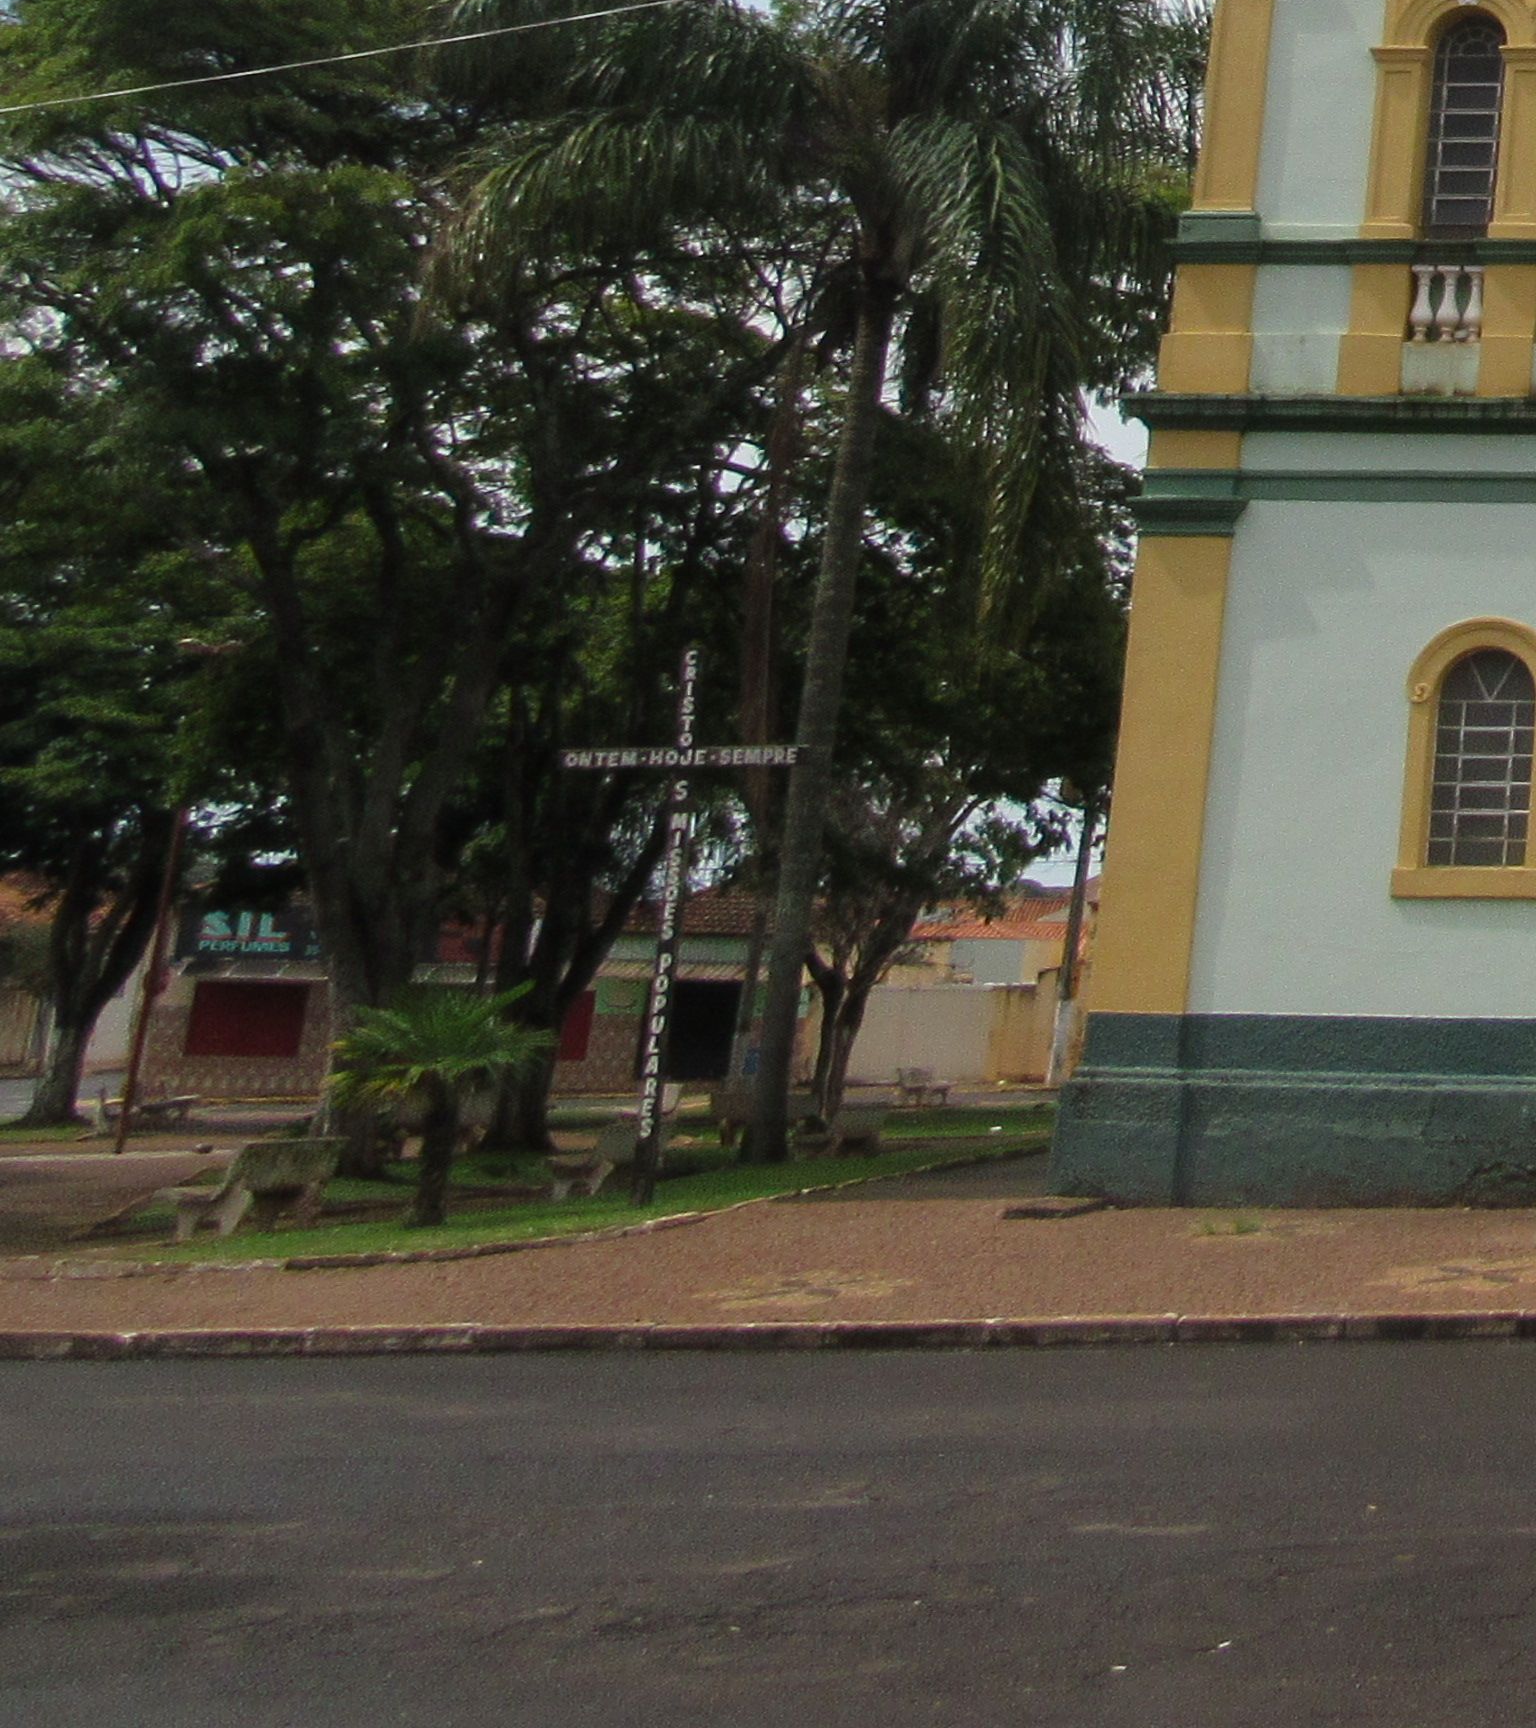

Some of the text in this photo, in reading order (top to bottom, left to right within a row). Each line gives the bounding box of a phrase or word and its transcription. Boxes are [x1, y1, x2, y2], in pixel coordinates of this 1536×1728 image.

[679, 650, 699, 748] CRISTO
[564, 746, 799, 767] ONTEM HOJE SEMPRE
[200, 910, 288, 938] SIL
[199, 939, 292, 953] PERFUMES
[639, 952, 673, 1139] POPULARES
